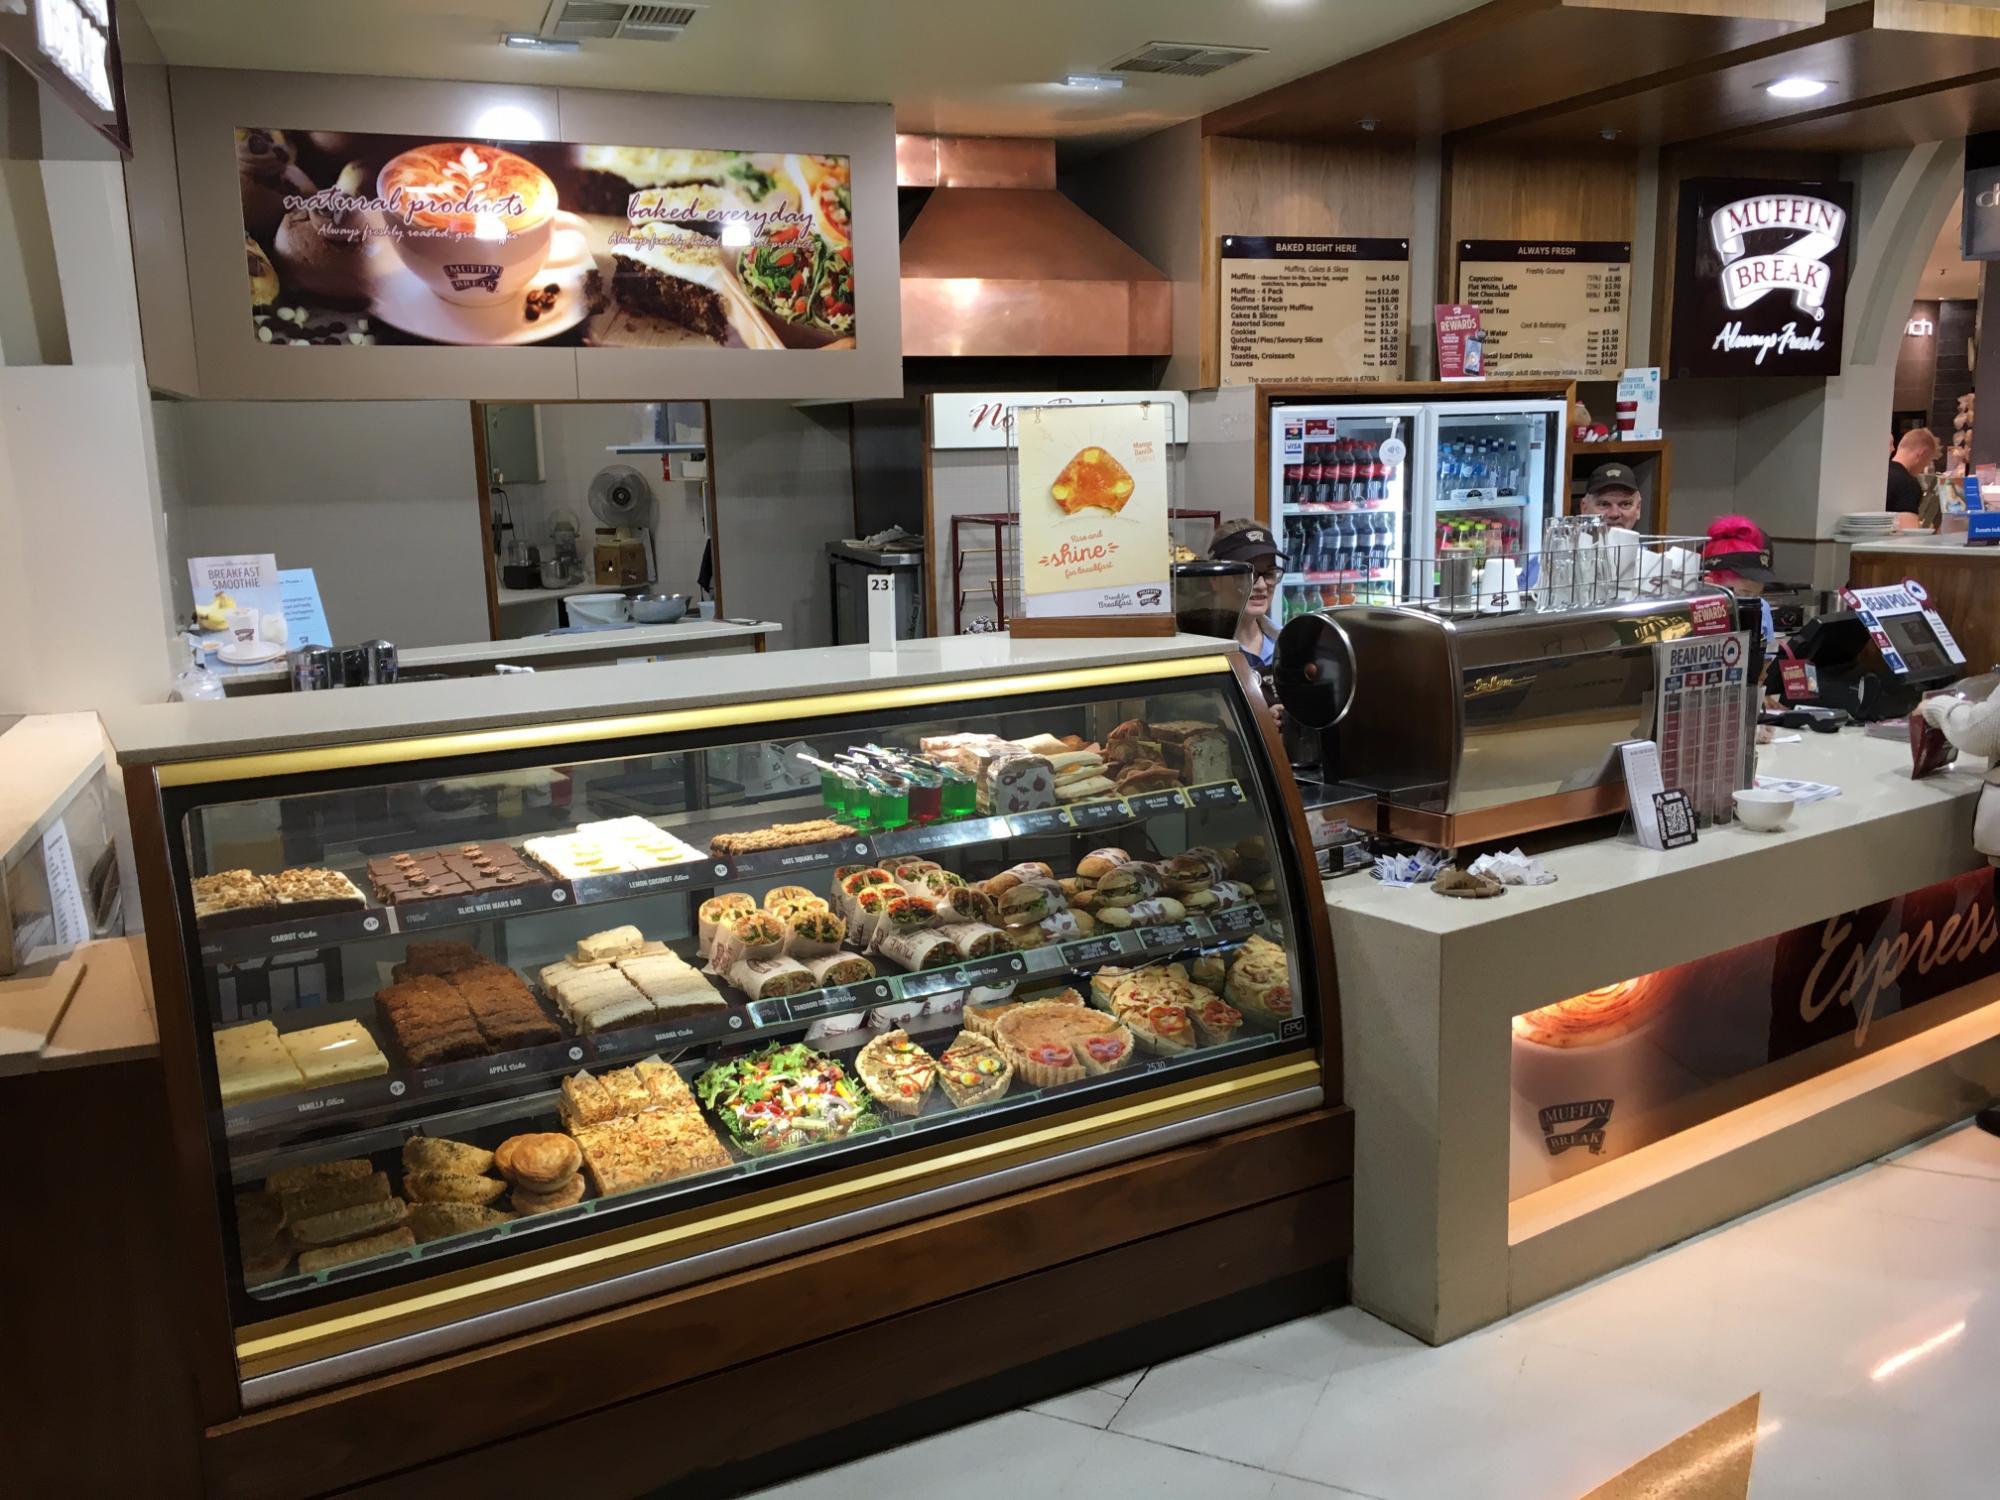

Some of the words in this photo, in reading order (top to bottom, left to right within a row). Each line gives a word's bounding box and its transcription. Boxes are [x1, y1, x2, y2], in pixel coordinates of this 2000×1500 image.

[283, 185, 400, 213] natural
[404, 190, 526, 224] products
[628, 193, 699, 220] baked
[706, 200, 816, 239] everyday
[1728, 198, 1837, 232] MUFFIN
[317, 223, 360, 243] Always
[361, 223, 404, 243] freshly
[1275, 243, 1304, 252] BAKED
[1306, 243, 1333, 252] RIGHT
[1335, 244, 1357, 253] HERE
[1518, 246, 1549, 255] ALWAYS
[1551, 247, 1576, 255] FRESH
[449, 264, 501, 274] MUFFIN
[1736, 259, 1822, 289] BREAK
[455, 280, 497, 289] BREAK
[1382, 274, 1400, 282] $4.50
[1261, 304, 1288, 312] Savoury
[1440, 319, 1477, 332] REWARDS
[1712, 321, 1778, 366] Always
[1777, 322, 1825, 355] Fresh
[1088, 529, 1104, 541] and
[1050, 543, 1107, 567] shine
[208, 566, 260, 580] BREAKFAST
[1065, 568, 1077, 580] for
[1078, 561, 1114, 575] breakfast
[212, 577, 260, 590] SMOOTHIE
[871, 579, 889, 591] 23
[1098, 599, 1133, 609] Breakfast
[1861, 595, 1894, 612] BEAN
[1887, 592, 1918, 610] POLL
[1693, 604, 1727, 624] REWARDS
[1670, 647, 1698, 667] BEAN
[1699, 643, 1723, 662] POLL
[628, 879, 648, 889] LEMON
[648, 875, 673, 886] COCONUT
[457, 906, 475, 915] SLICE
[476, 903, 492, 912] WITH
[492, 900, 509, 910] MARS
[510, 898, 522, 906] BAR
[271, 932, 296, 943] CARROT
[489, 1065, 508, 1075] APPLE
[297, 1101, 325, 1112] VANILLA
[1544, 1102, 1607, 1122] MUFFIN
[1550, 1132, 1600, 1148] BREAK
